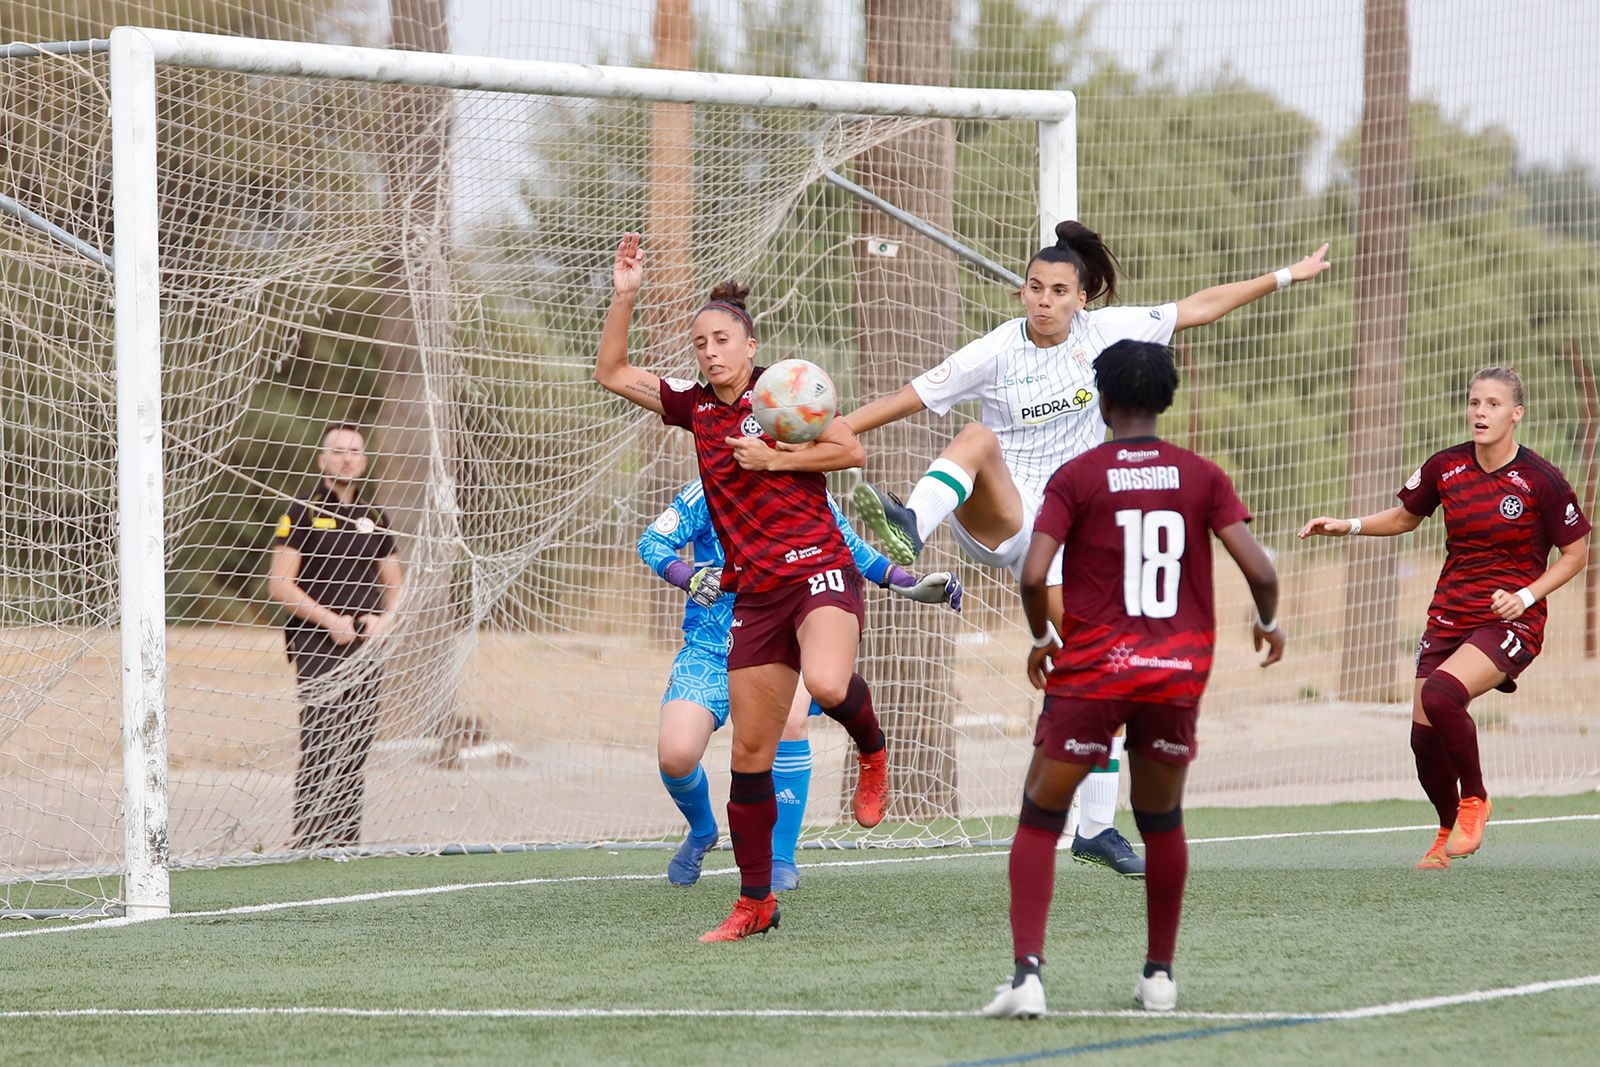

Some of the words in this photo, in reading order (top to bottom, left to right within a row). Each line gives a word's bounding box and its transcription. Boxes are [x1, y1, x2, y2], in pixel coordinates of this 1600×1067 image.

[1021, 398, 1071, 420] PiEDRA
[1107, 465, 1180, 493] BASSIRA
[1115, 509, 1186, 618] 18
[808, 569, 845, 596] 20
[1500, 629, 1521, 657] 11
